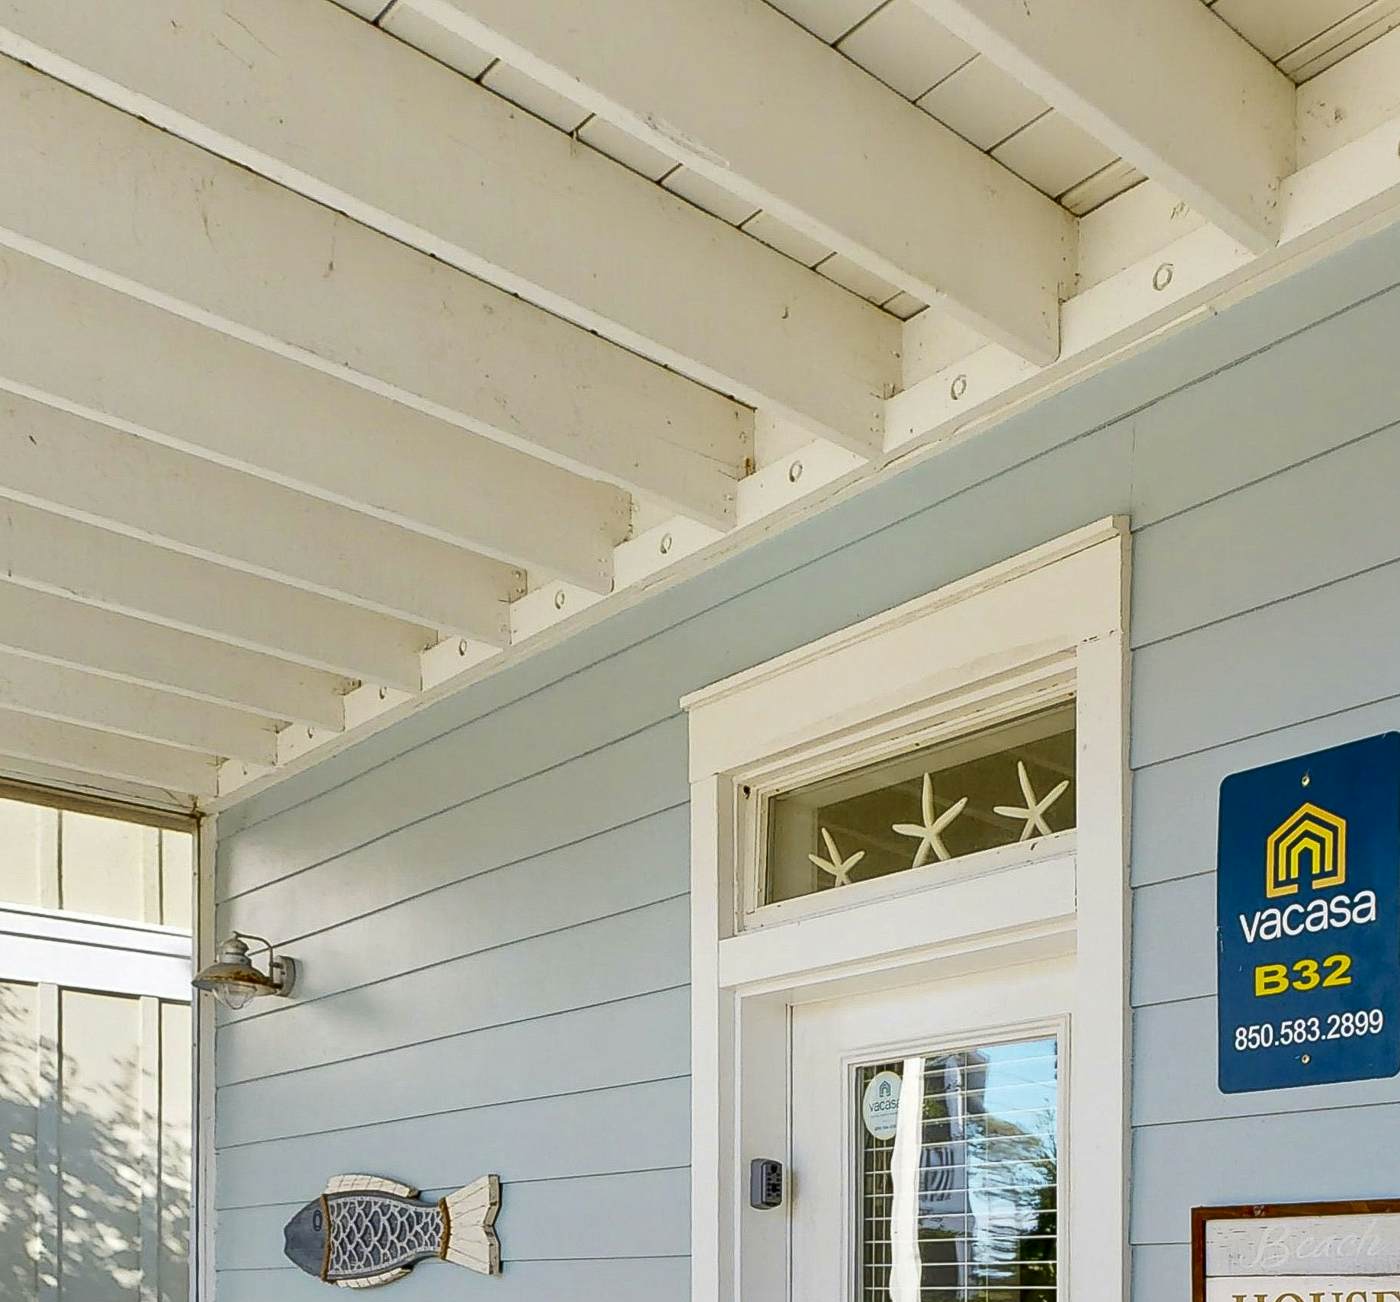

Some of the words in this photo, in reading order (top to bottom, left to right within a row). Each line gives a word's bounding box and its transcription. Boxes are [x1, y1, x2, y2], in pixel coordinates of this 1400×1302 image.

[1239, 889, 1377, 943] vacasa
[1255, 953, 1352, 997] B32
[1235, 1009, 1384, 1050] 850.583.2899
[1239, 1219, 1386, 1269] Beach
